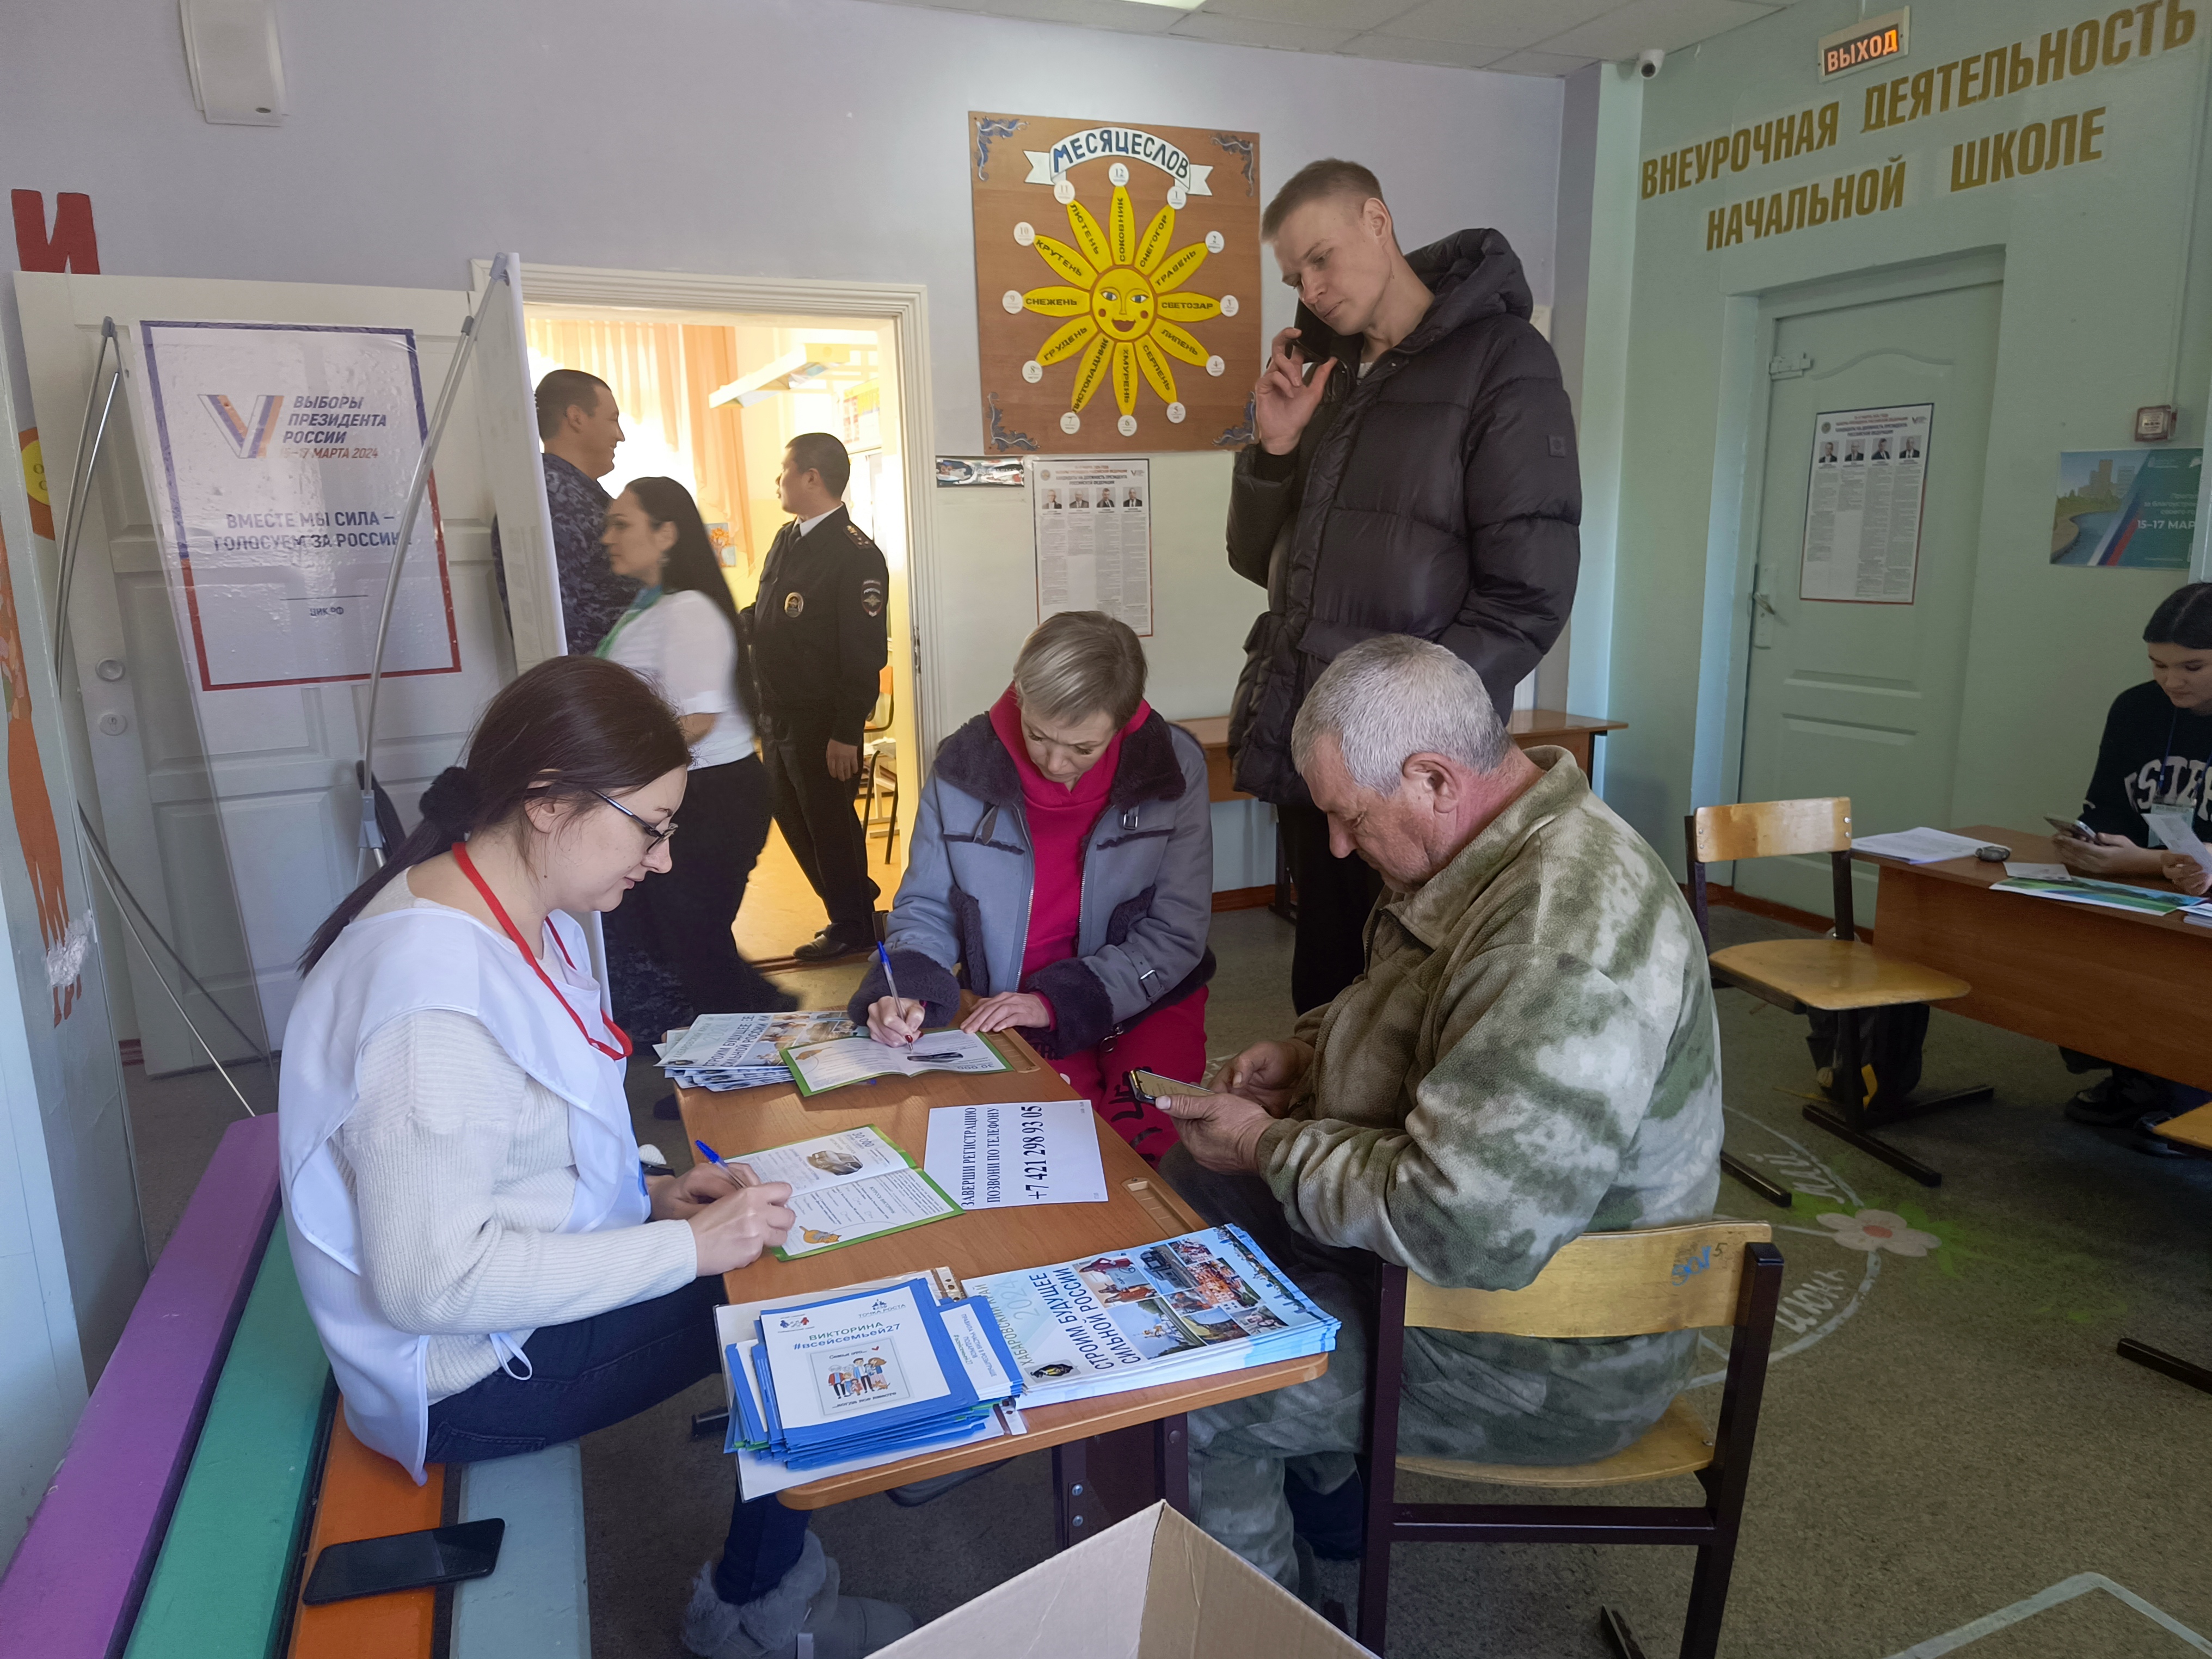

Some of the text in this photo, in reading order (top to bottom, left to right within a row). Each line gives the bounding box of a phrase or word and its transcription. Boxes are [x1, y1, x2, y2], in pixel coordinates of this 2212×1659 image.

[1826, 28, 1898, 72] ВЫХОД
[1641, 0, 2196, 200] ВНЕУРОЧНАЯ ДЕЯТЕЛЬНОСТЬ
[1053, 130, 1188, 179] МЕСЯЦЕСЛОВ
[1115, 168, 1124, 176] 12
[1060, 185, 1068, 193] 11
[1706, 107, 2106, 250] НАЧАЛЬНОЙ ШКОЛЕ
[1070, 204, 1099, 255] ЛЮТЕНЬ
[1117, 198, 1126, 262] СОКОВНИК
[1140, 215, 1167, 267] СНЕГОГОР
[1036, 239, 1083, 276] КРУТЕНЬ
[1154, 250, 1196, 286] ТРАВЕНЬ
[1226, 299, 1232, 307] 3
[1043, 328, 1087, 361] ГРУДЕНЬ
[1161, 329, 1198, 355] ЛИПЕНЬ
[1030, 366, 1035, 374] 8
[1072, 337, 1109, 414] ЛИСТОПАДНИК
[1143, 345, 1170, 391] СЕРПЕНЬ
[287, 414, 387, 428] ПРЕЗИДЕНТА
[293, 396, 364, 410] ВЫБОРЫ
[1067, 416, 1072, 425] 7
[282, 431, 347, 444] РОССИИ
[313, 448, 349, 459] МАРТА
[352, 448, 379, 459] 2024
[226, 513, 296, 529] ВМЕСТЕ
[299, 512, 330, 527] МЫ
[335, 512, 380, 526] СИЛА
[311, 534, 332, 548] ЗА
[703, 1024, 753, 1067] СТРОИМ БУДУЩЕЕ
[720, 1023, 769, 1067] СИЛЬНОЙ РОССИИ
[961, 1107, 980, 1207] ЗАВЕРШИ РЕГИСТРАЦИЮ
[987, 1108, 1000, 1203] ПОЗВОНИ ПО ТЕЛЕФОНУ
[1021, 1105, 1049, 1199] +7 421 298 93 05
[882, 1304, 906, 1313] РОСТА
[994, 1278, 1040, 1320] 2024
[1053, 1268, 1141, 1365] СИЛЬНОЙ РОССИИ
[793, 1323, 901, 1350] #всейсемьей27
[809, 1322, 883, 1341] ВИКТОРИНА
[1029, 1273, 1114, 1371] СТРОИМ БУДУЩЕЕ
